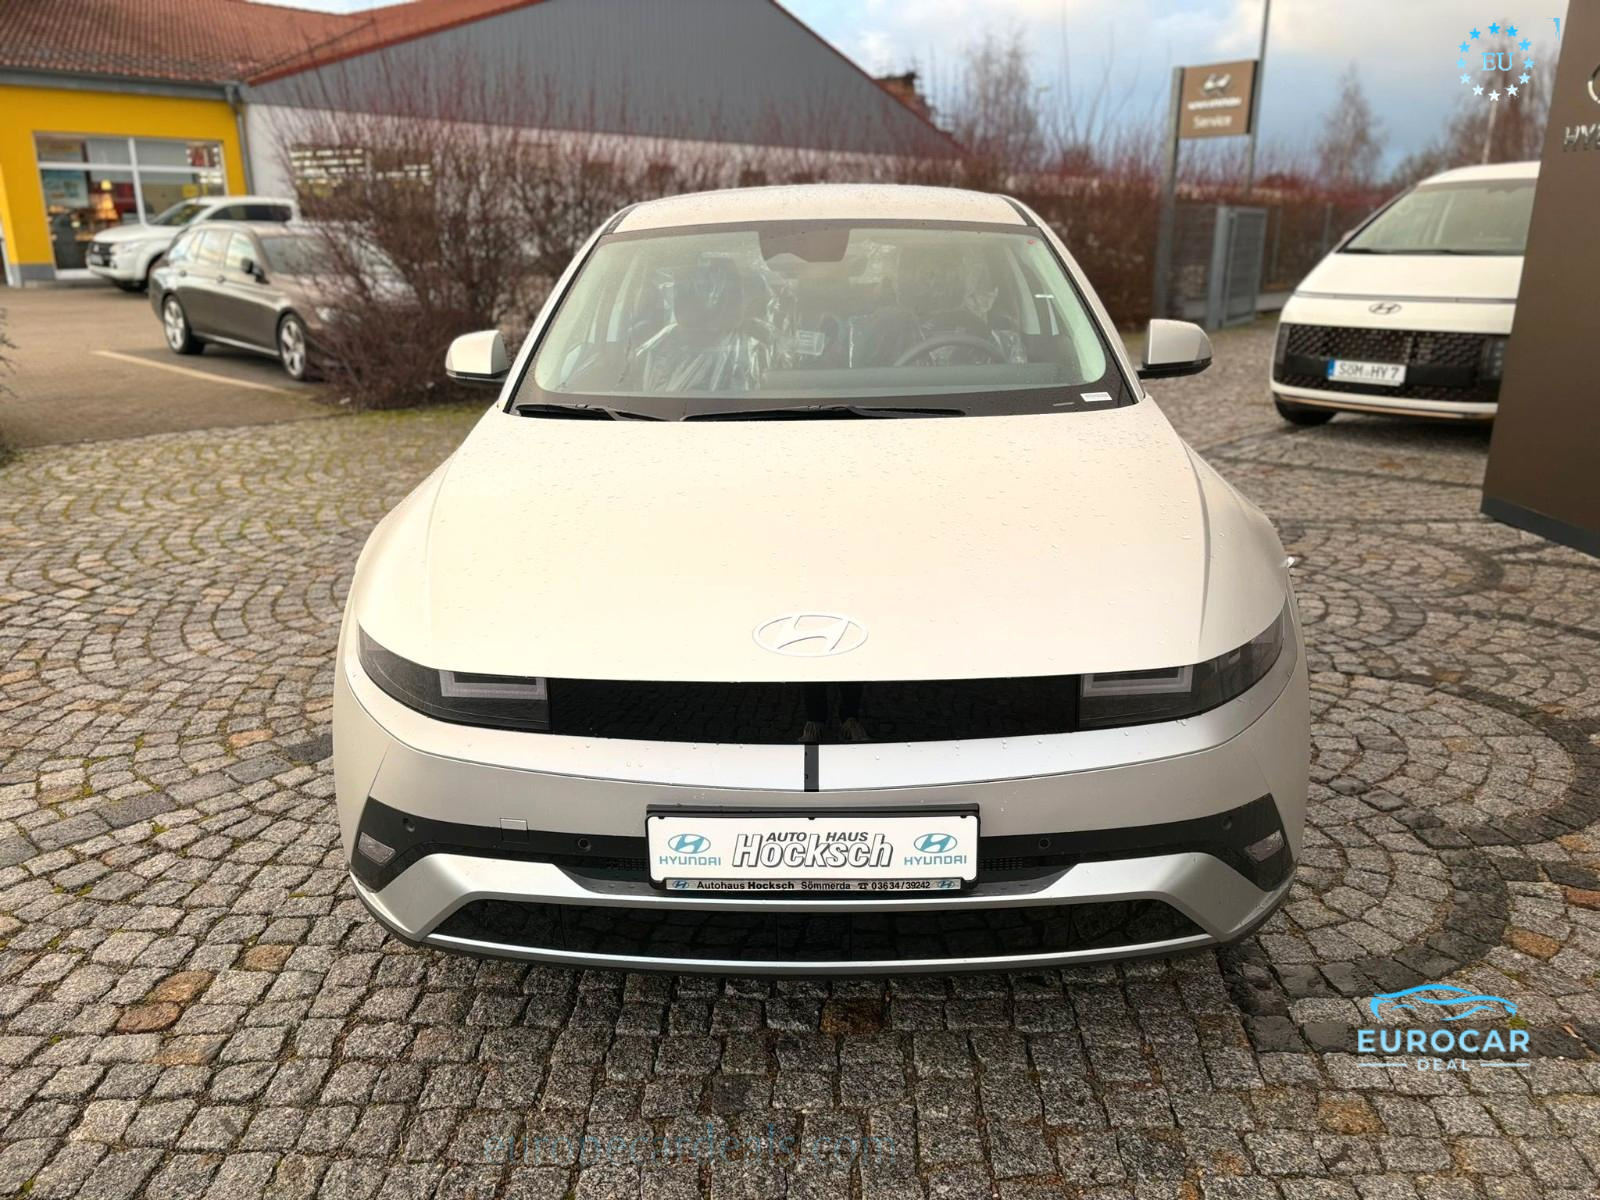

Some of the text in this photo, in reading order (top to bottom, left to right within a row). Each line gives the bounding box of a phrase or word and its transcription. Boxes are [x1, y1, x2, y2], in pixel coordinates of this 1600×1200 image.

[766, 832, 869, 842] AUTO HAUS
[732, 833, 894, 868] Hocksch
[659, 855, 721, 866] HYUNDAI
[904, 855, 967, 866] HYUNDAI
[697, 881, 745, 890] Autohaus
[747, 881, 795, 890] Hocksch
[801, 880, 851, 890] Sömmerda
